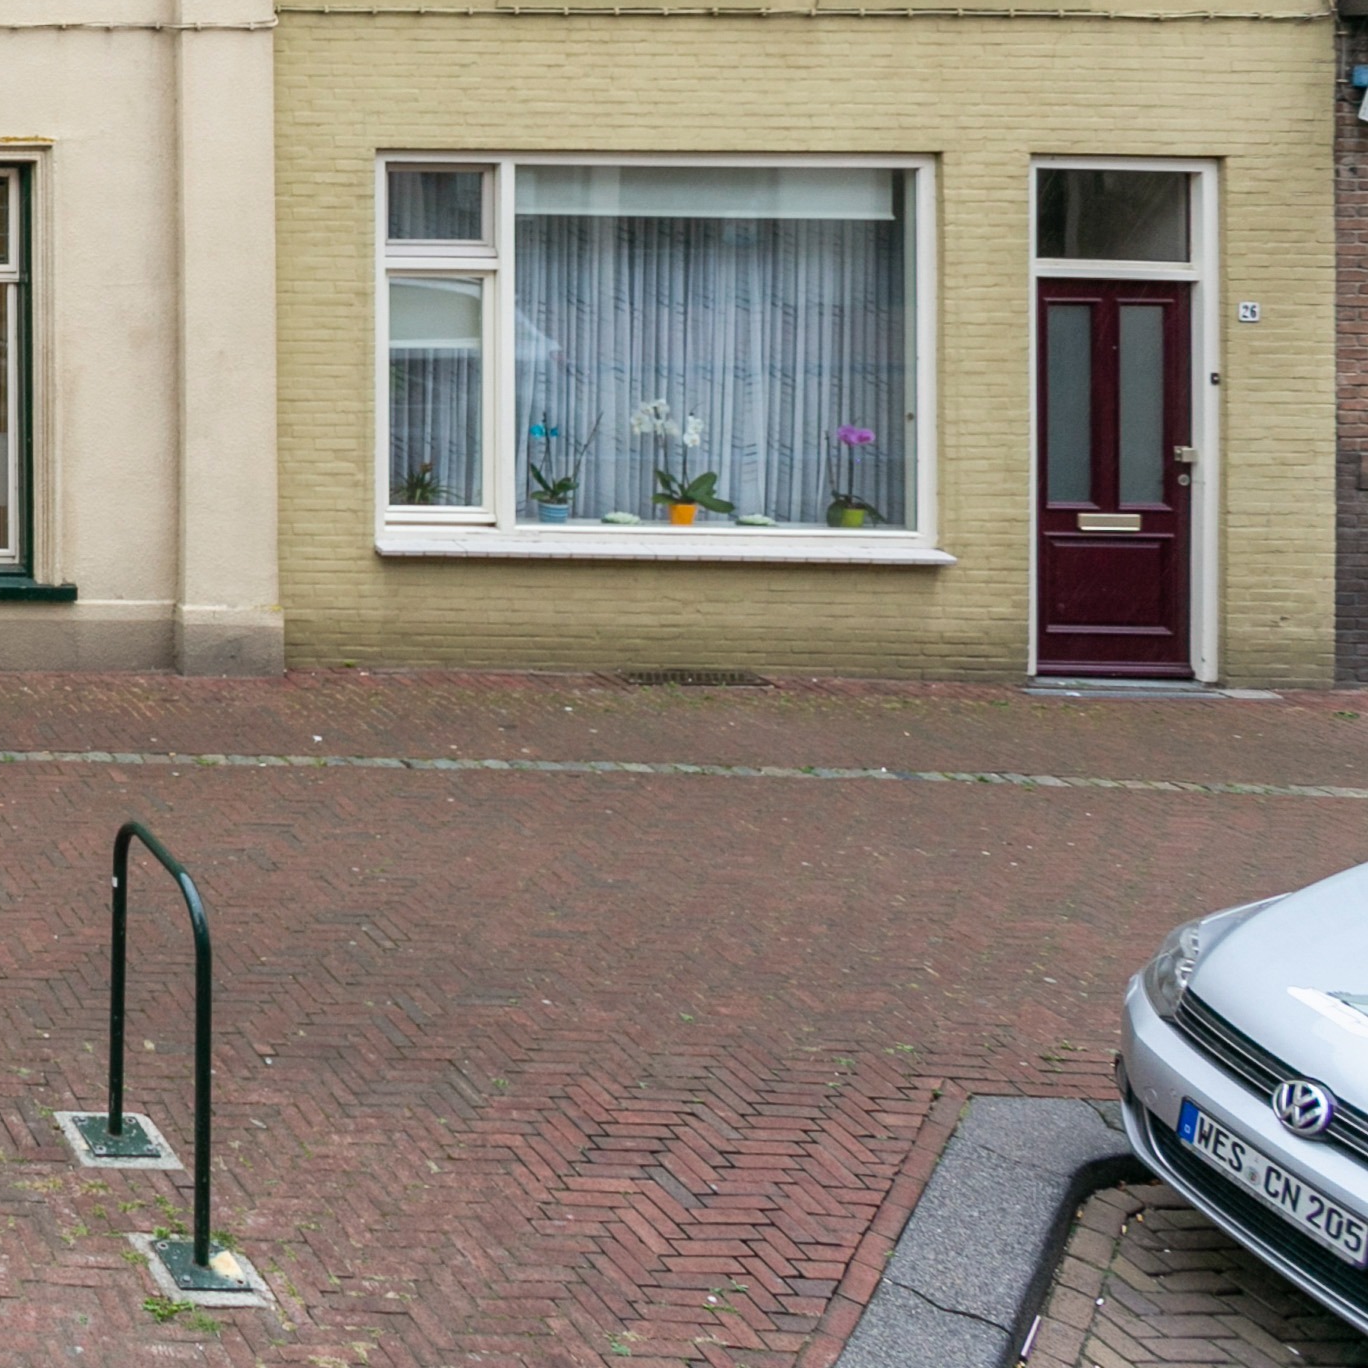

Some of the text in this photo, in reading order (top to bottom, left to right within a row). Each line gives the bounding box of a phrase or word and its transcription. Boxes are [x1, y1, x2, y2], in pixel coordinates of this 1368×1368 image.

[1242, 304, 1257, 319] 26
[1197, 1116, 1246, 1173] WES
[1263, 1165, 1302, 1213] CN
[1305, 1194, 1364, 1253] 205
